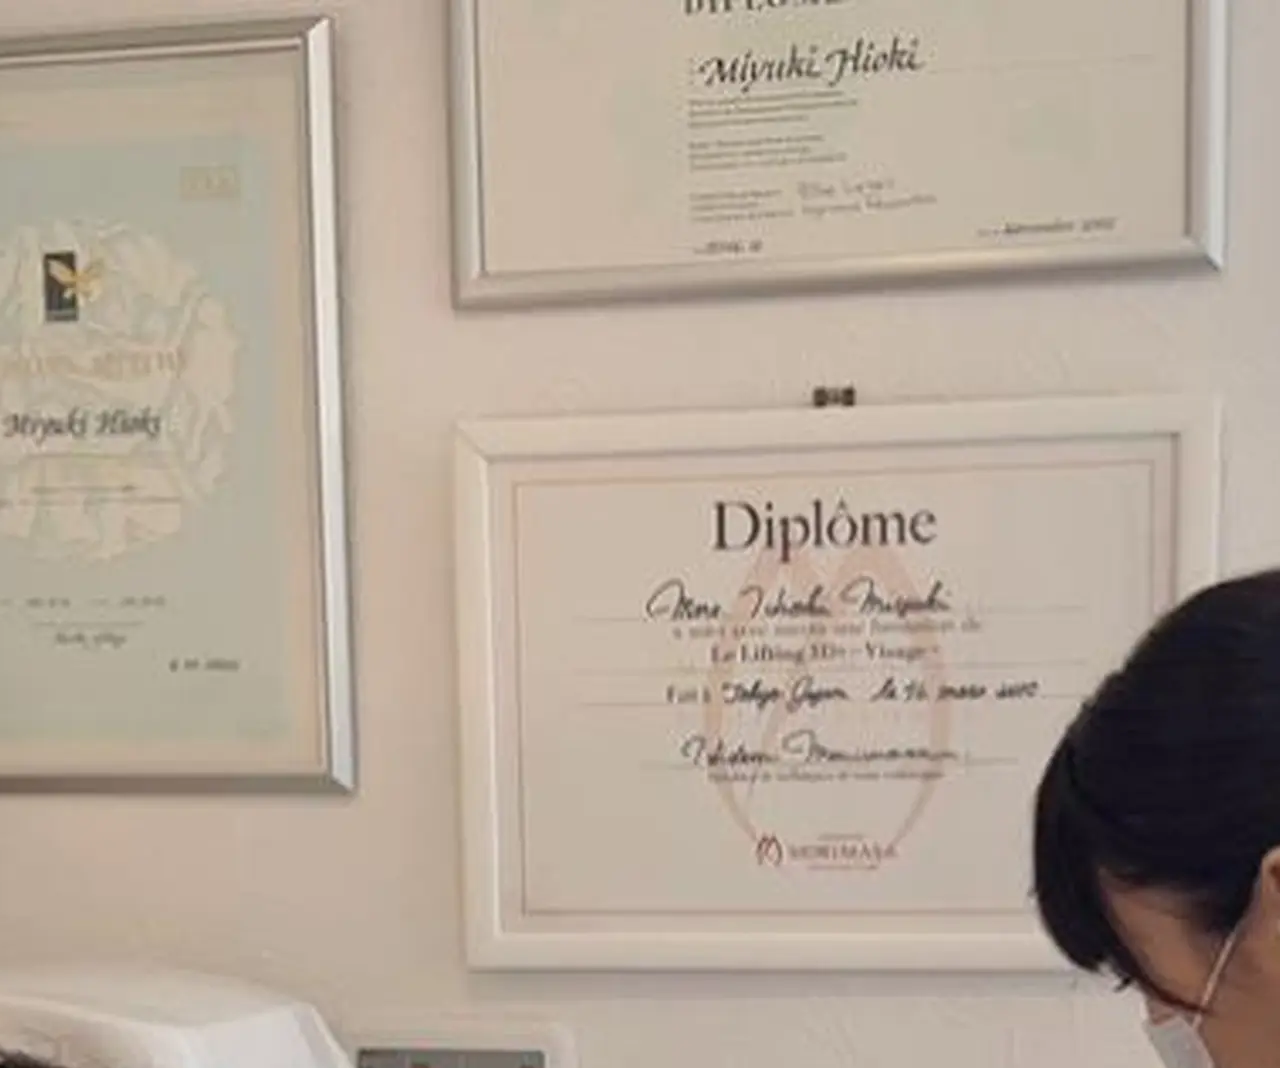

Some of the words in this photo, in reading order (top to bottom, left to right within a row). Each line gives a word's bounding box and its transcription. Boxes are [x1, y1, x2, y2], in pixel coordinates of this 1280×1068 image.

[697, 43, 821, 92] Miyuki
[823, 36, 927, 87] Hioki
[713, 498, 937, 562] Diplôme
